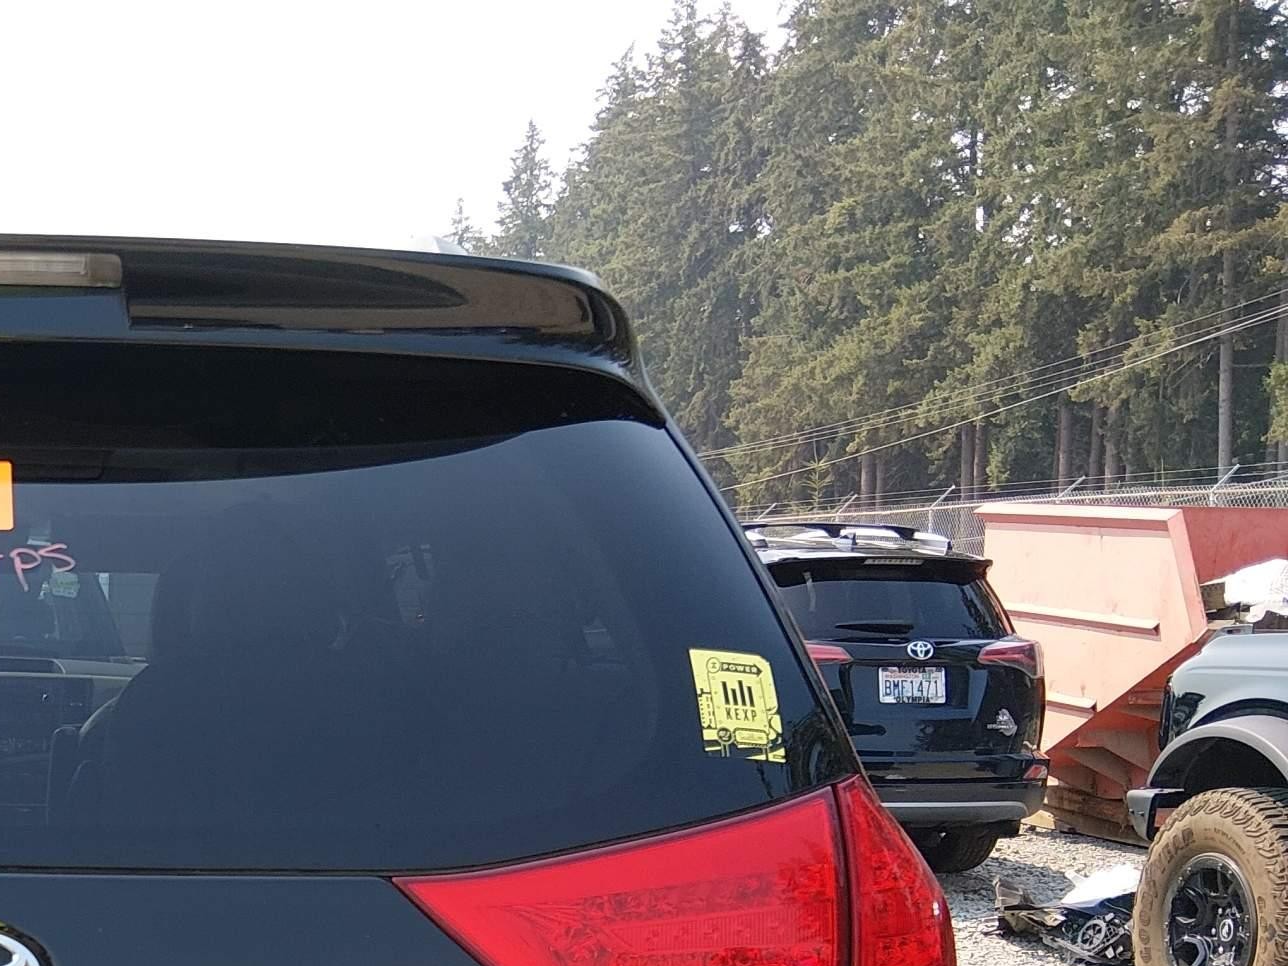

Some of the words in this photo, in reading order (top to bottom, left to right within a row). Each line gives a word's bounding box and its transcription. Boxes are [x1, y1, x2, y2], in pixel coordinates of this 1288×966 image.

[722, 663, 759, 674] POWER
[897, 663, 927, 674] TOYOTA
[725, 707, 758, 722] KEXP
